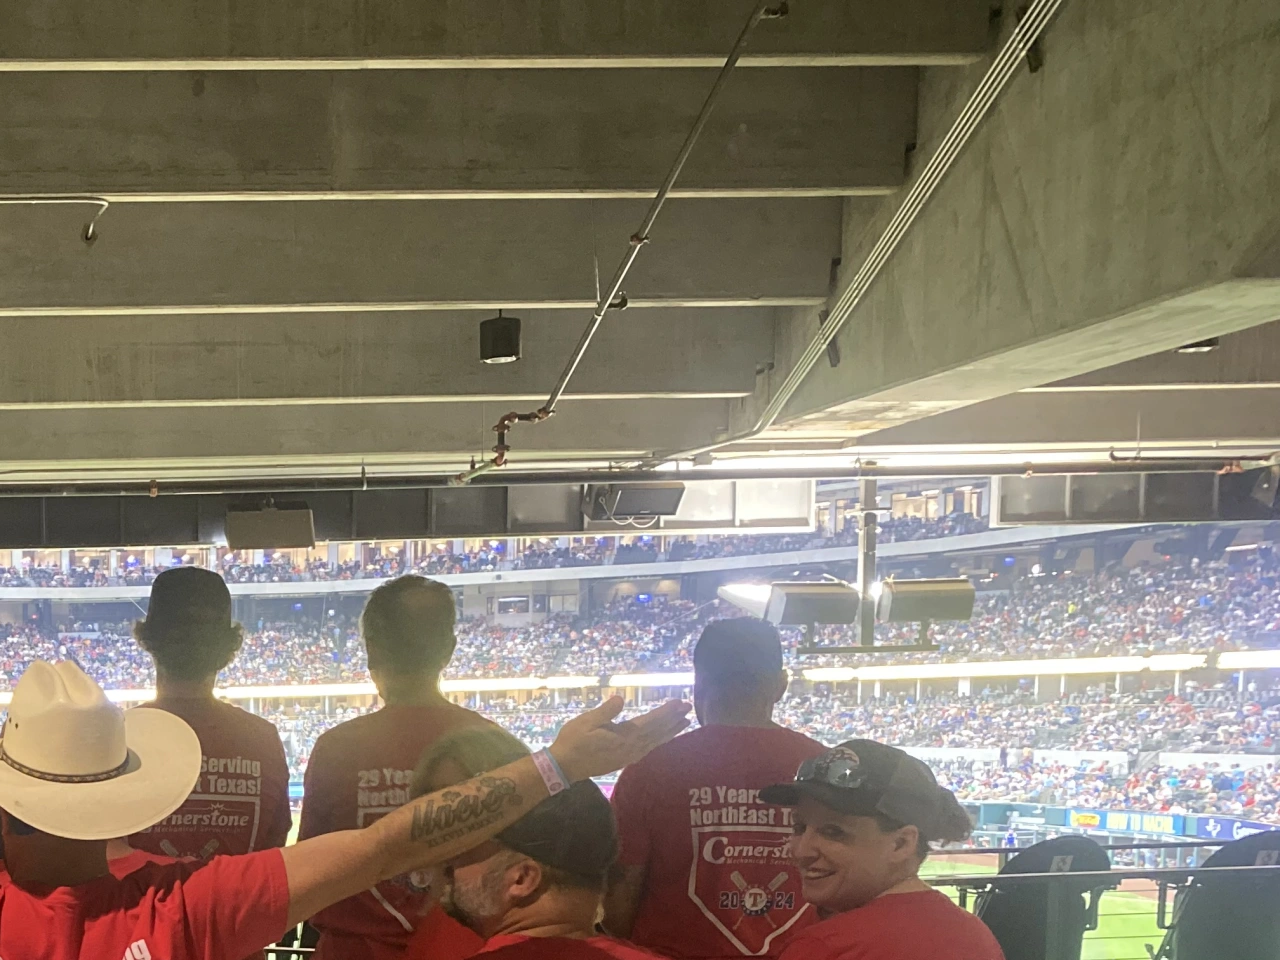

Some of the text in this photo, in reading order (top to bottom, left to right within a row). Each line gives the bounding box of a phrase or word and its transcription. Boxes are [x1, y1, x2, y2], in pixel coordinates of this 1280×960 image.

[207, 775, 261, 795] Texas!
[357, 769, 380, 786] 29
[689, 787, 712, 806] 29
[690, 806, 776, 825] NorthEast
[720, 892, 739, 909] 20
[775, 892, 794, 909] 24
